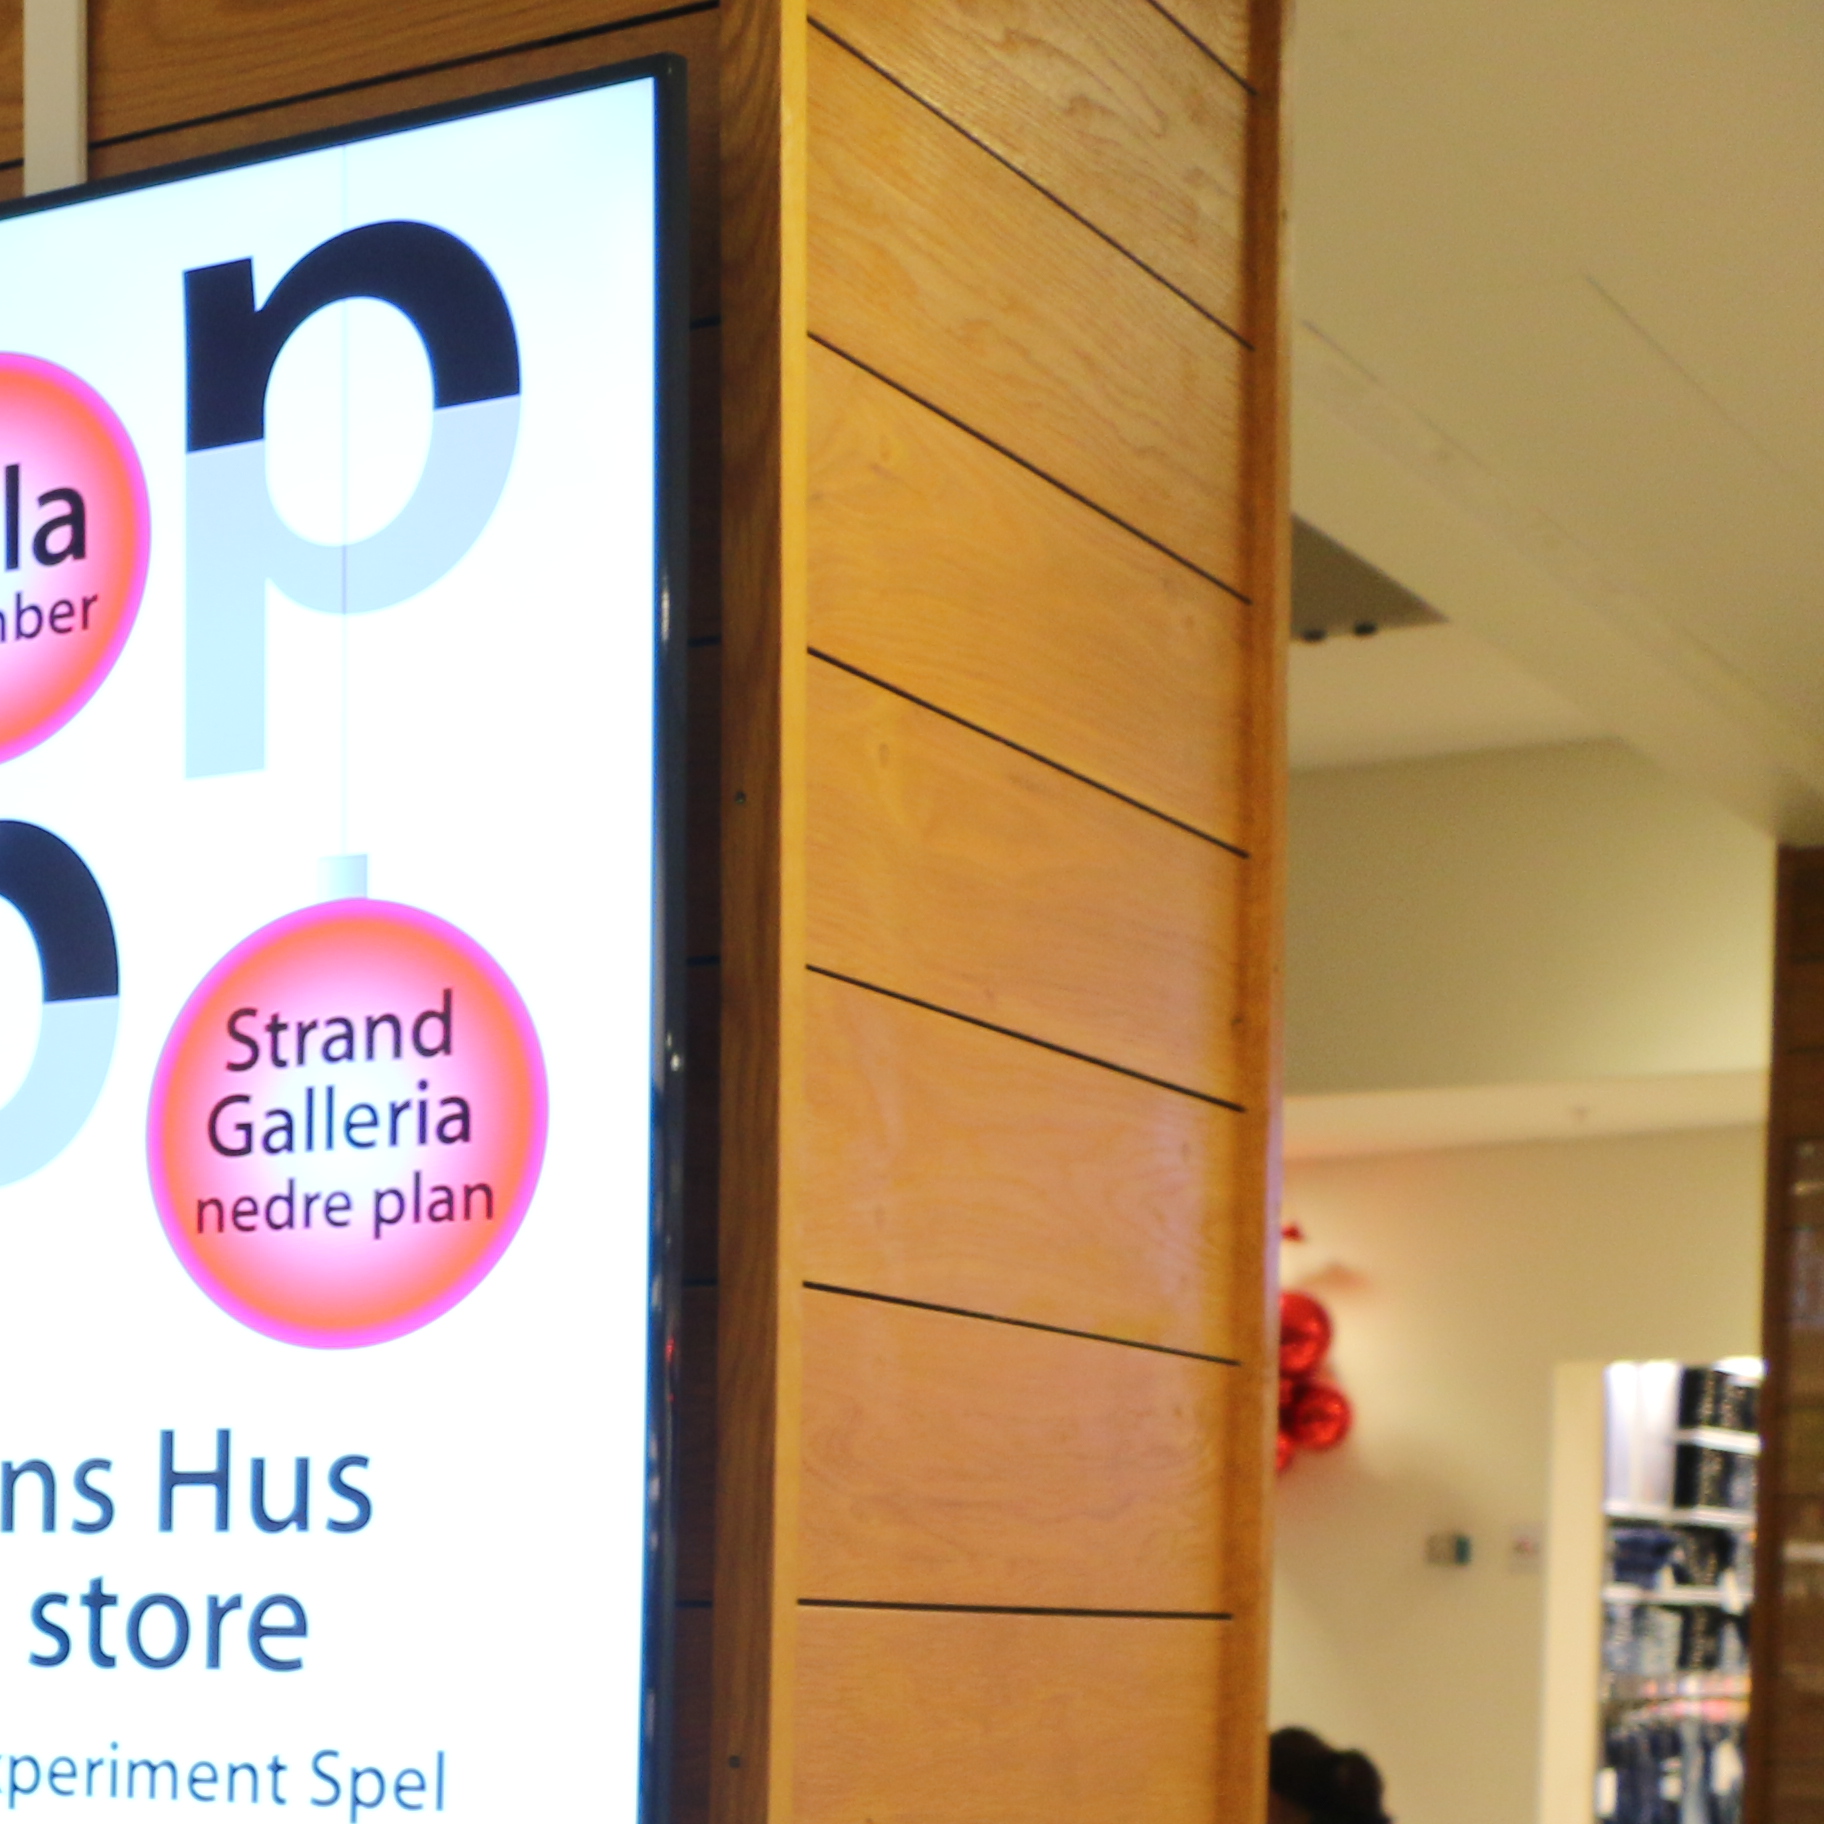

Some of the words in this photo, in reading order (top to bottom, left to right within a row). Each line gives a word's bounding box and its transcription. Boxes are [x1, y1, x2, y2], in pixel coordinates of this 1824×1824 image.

[226, 988, 453, 1073] Strand
[207, 1080, 473, 1159] Galleria
[195, 1175, 353, 1234] nedre
[372, 1170, 495, 1241] plan
[157, 1427, 374, 1535] Hus
[27, 1575, 310, 1673] store
